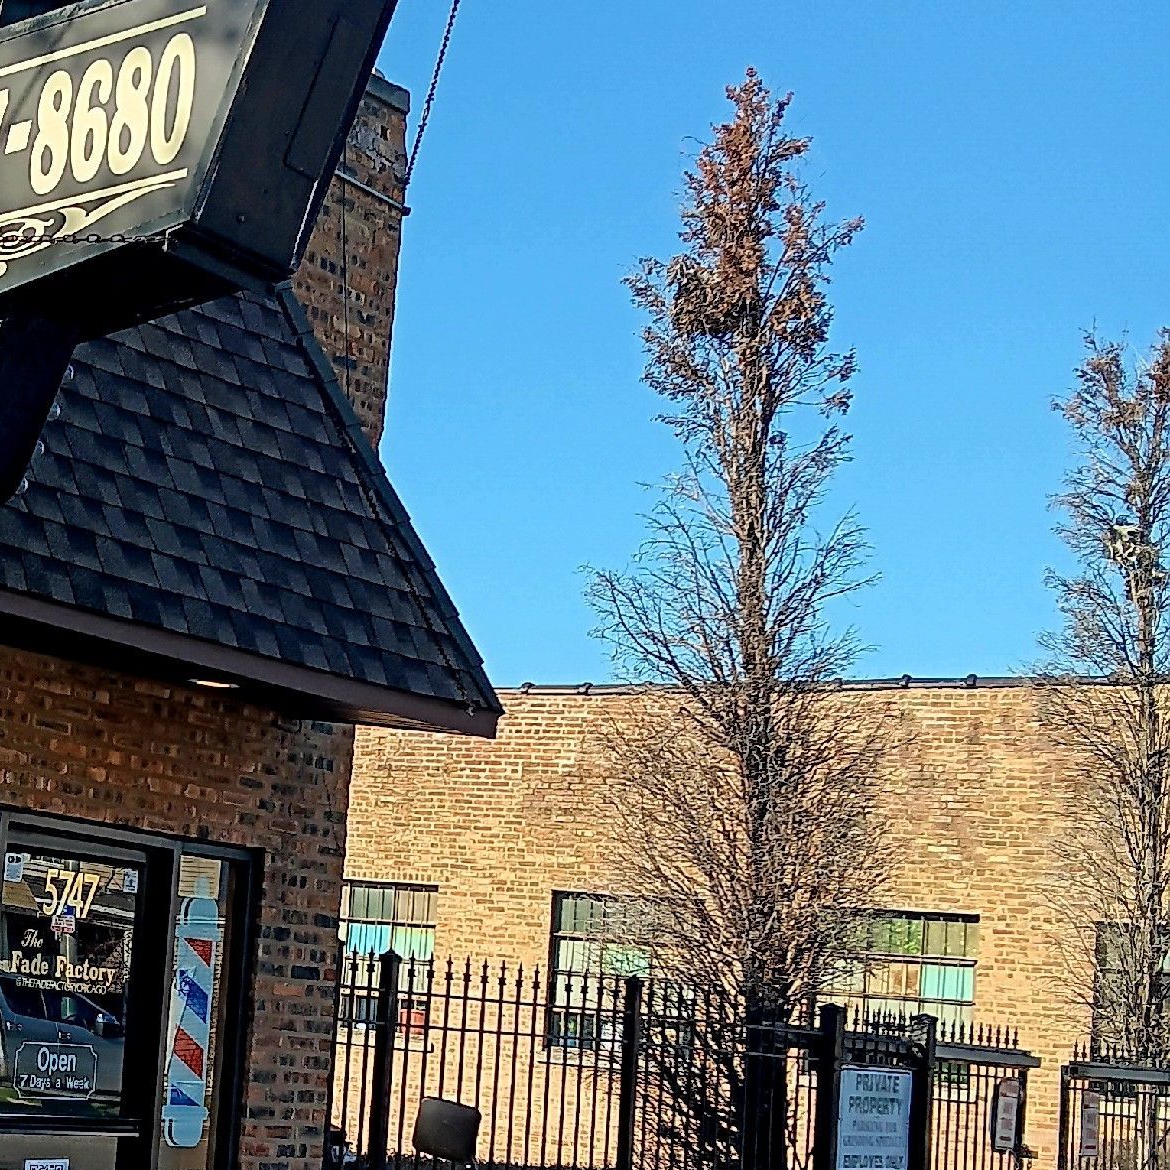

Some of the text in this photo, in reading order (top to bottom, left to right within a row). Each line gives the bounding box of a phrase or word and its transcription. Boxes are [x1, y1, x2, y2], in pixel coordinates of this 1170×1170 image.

[43, 869, 100, 919] 5747
[21, 929, 44, 948] The
[11, 951, 115, 987] Fade Factory
[37, 1046, 77, 1076] Open
[20, 1075, 90, 1091] 7 Days a Week
[856, 1074, 899, 1093] PRIVATE
[849, 1096, 901, 1115] PROPERTY
